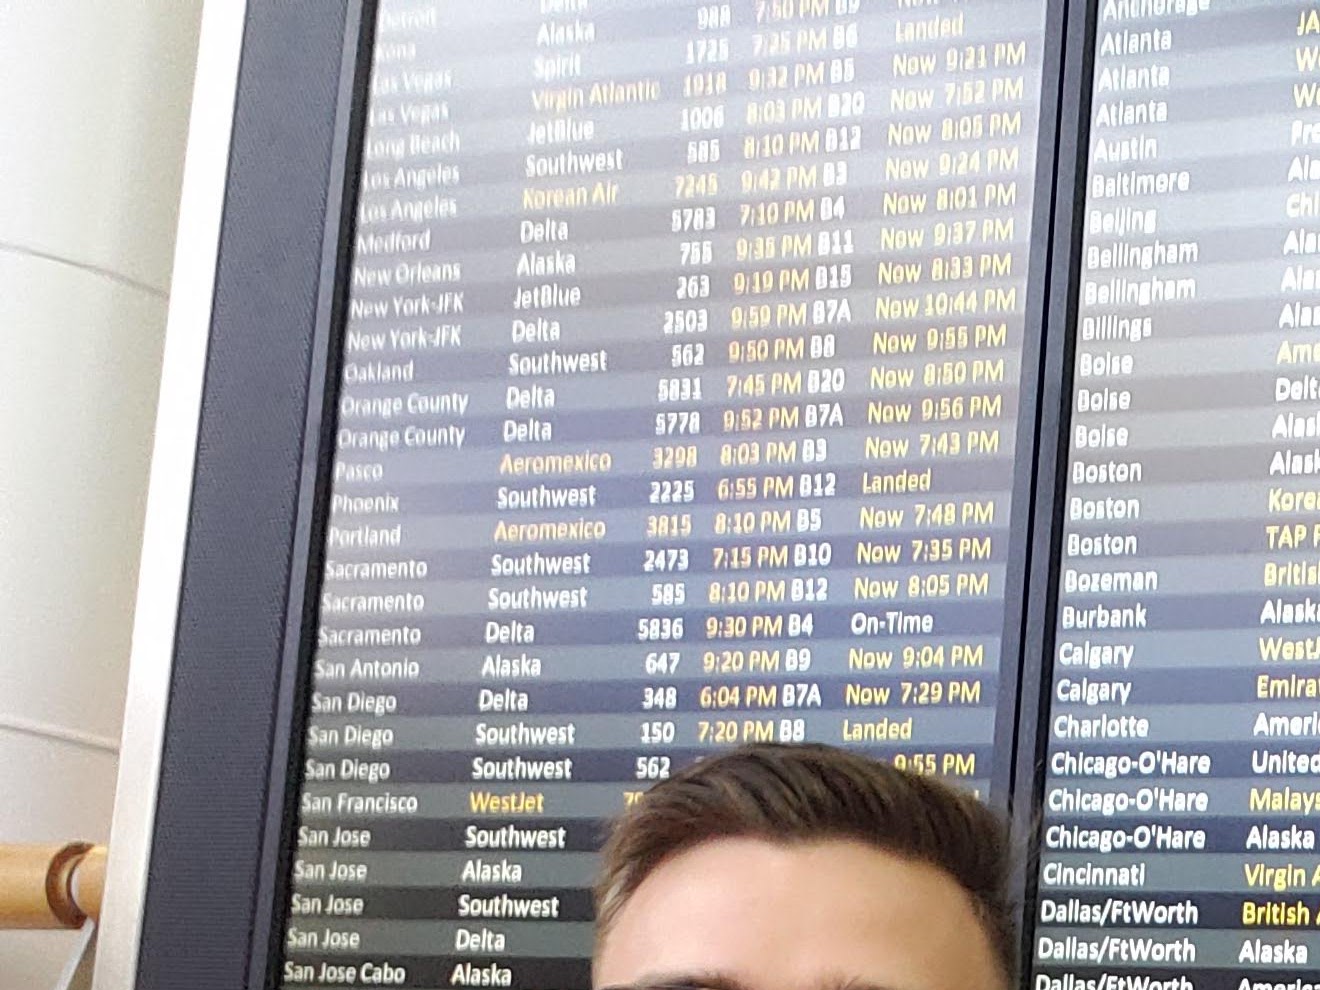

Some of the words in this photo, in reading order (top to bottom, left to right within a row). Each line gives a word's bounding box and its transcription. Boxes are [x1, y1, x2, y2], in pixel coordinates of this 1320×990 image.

[1093, 100, 1168, 126] Atlanta
[1087, 207, 1157, 237] Beijing
[496, 485, 597, 510] Southwest
[762, 476, 794, 499] PM
[862, 469, 932, 494] Landed
[1068, 534, 1138, 557] Boston
[1266, 525, 1307, 549] TAP
[1059, 641, 1135, 670] Calgary
[311, 693, 343, 713] San
[347, 692, 397, 717] Diego
[478, 688, 529, 712] Delta
[642, 687, 677, 710] 348
[699, 686, 740, 708] 6:04
[745, 686, 777, 707] PM
[781, 684, 822, 707] B7A
[845, 684, 891, 706] Now
[900, 682, 943, 705] 7:29
[947, 681, 981, 704] PM
[1057, 678, 1132, 706] Calgary
[307, 726, 339, 746] San
[344, 726, 394, 750] Diego
[475, 722, 576, 745] Southwest
[640, 722, 675, 744] 150
[698, 721, 738, 743] 7:20
[742, 721, 774, 742] PM
[778, 719, 805, 743] B8
[842, 718, 913, 742] Landed
[1054, 714, 1150, 739] Charlotte
[304, 759, 336, 780] San
[339, 759, 391, 783] Diego
[471, 756, 573, 780] Southwest
[635, 757, 671, 780] 562
[1051, 750, 1211, 779] Chicago-O'Hare
[301, 793, 332, 813] San
[336, 793, 419, 814] Francisco
[469, 792, 544, 813] WestJet
[297, 826, 329, 847] San
[332, 827, 371, 847] Jose
[464, 825, 567, 849] Southwest
[1046, 825, 1206, 853] Chicago-O'Hare
[1246, 825, 1315, 850] Alaska
[1043, 863, 1146, 886] Cincinnati
[1245, 864, 1306, 892] Virgin
[1041, 899, 1199, 926] Dallas/FtWorth
[1243, 901, 1310, 926] British
[283, 961, 315, 982] San
[317, 963, 356, 984] Jose
[359, 964, 406, 984] Cabo
[450, 963, 512, 987] Alaska
